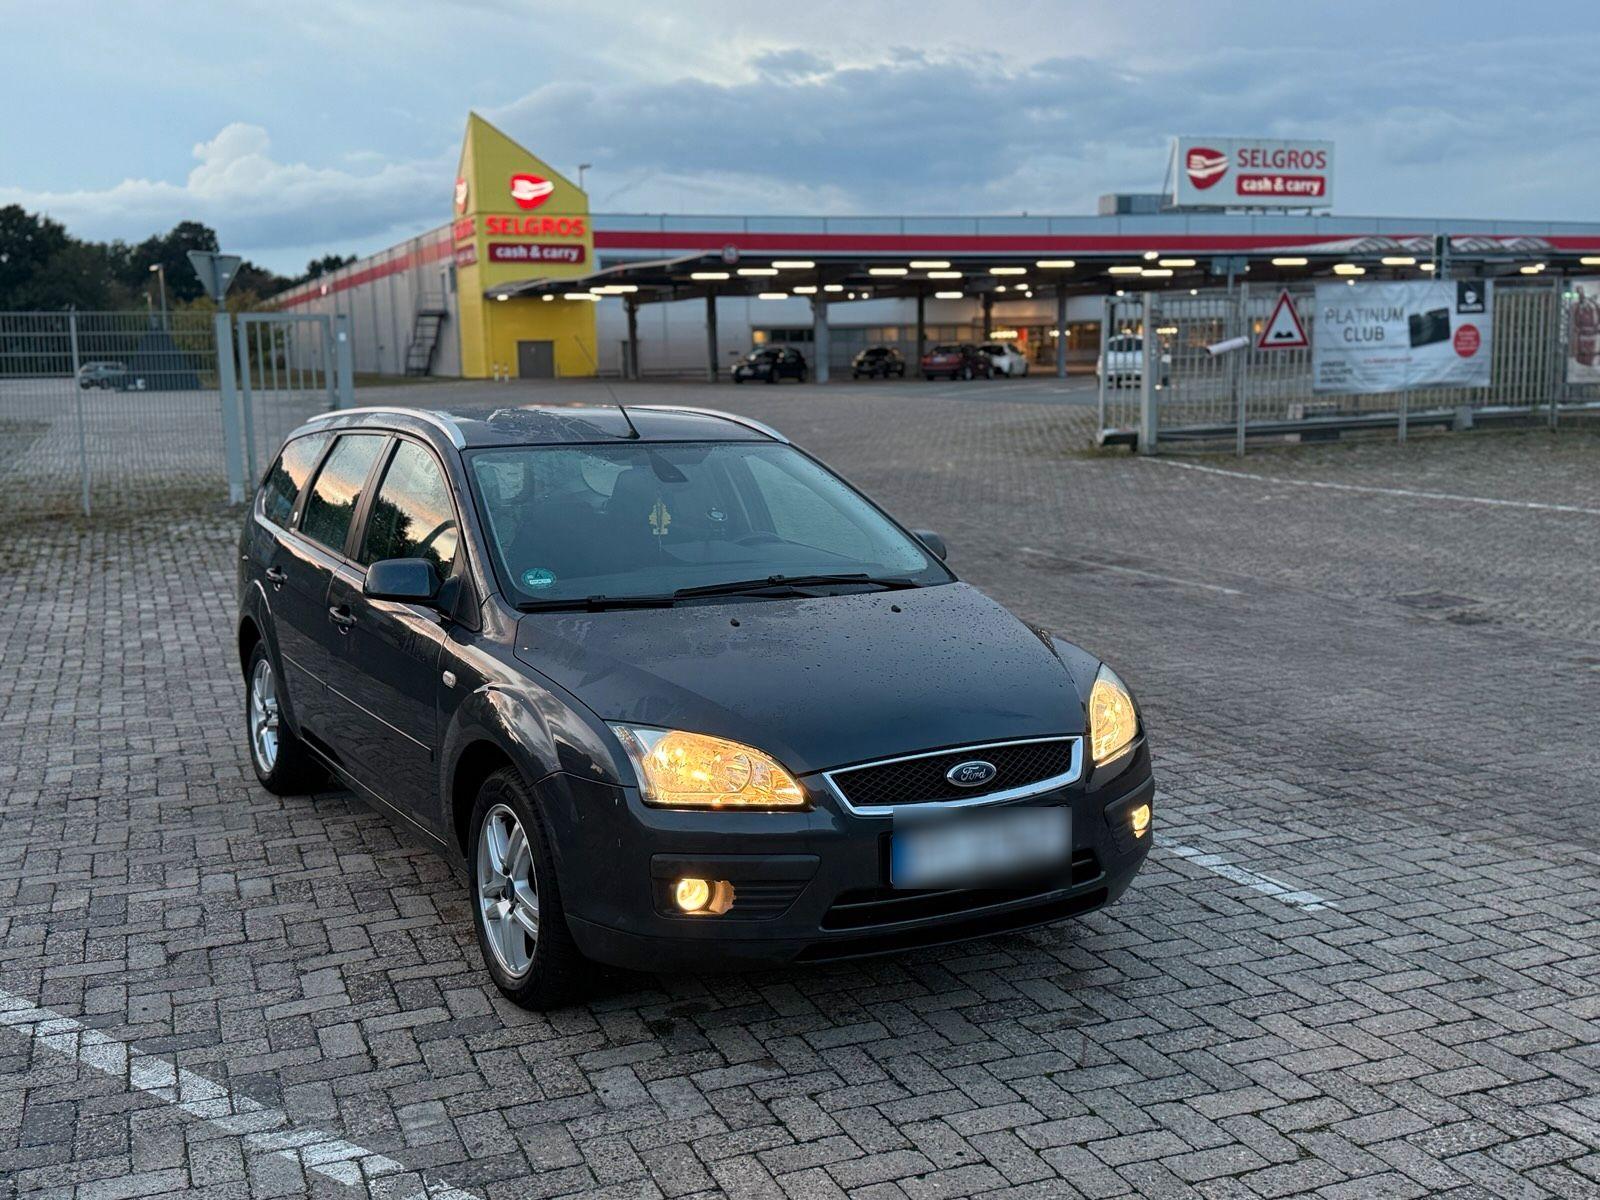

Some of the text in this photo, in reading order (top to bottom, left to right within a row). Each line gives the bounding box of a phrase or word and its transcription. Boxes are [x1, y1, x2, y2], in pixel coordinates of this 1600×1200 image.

[1237, 149, 1327, 169] SELGROS
[1241, 176, 1321, 195] cash & carry
[485, 215, 586, 237] SELGROS
[495, 246, 579, 262] cash & carry
[1325, 307, 1404, 325] PLATINUM
[1343, 327, 1385, 343] CLUB
[961, 766, 986, 781] Ford
